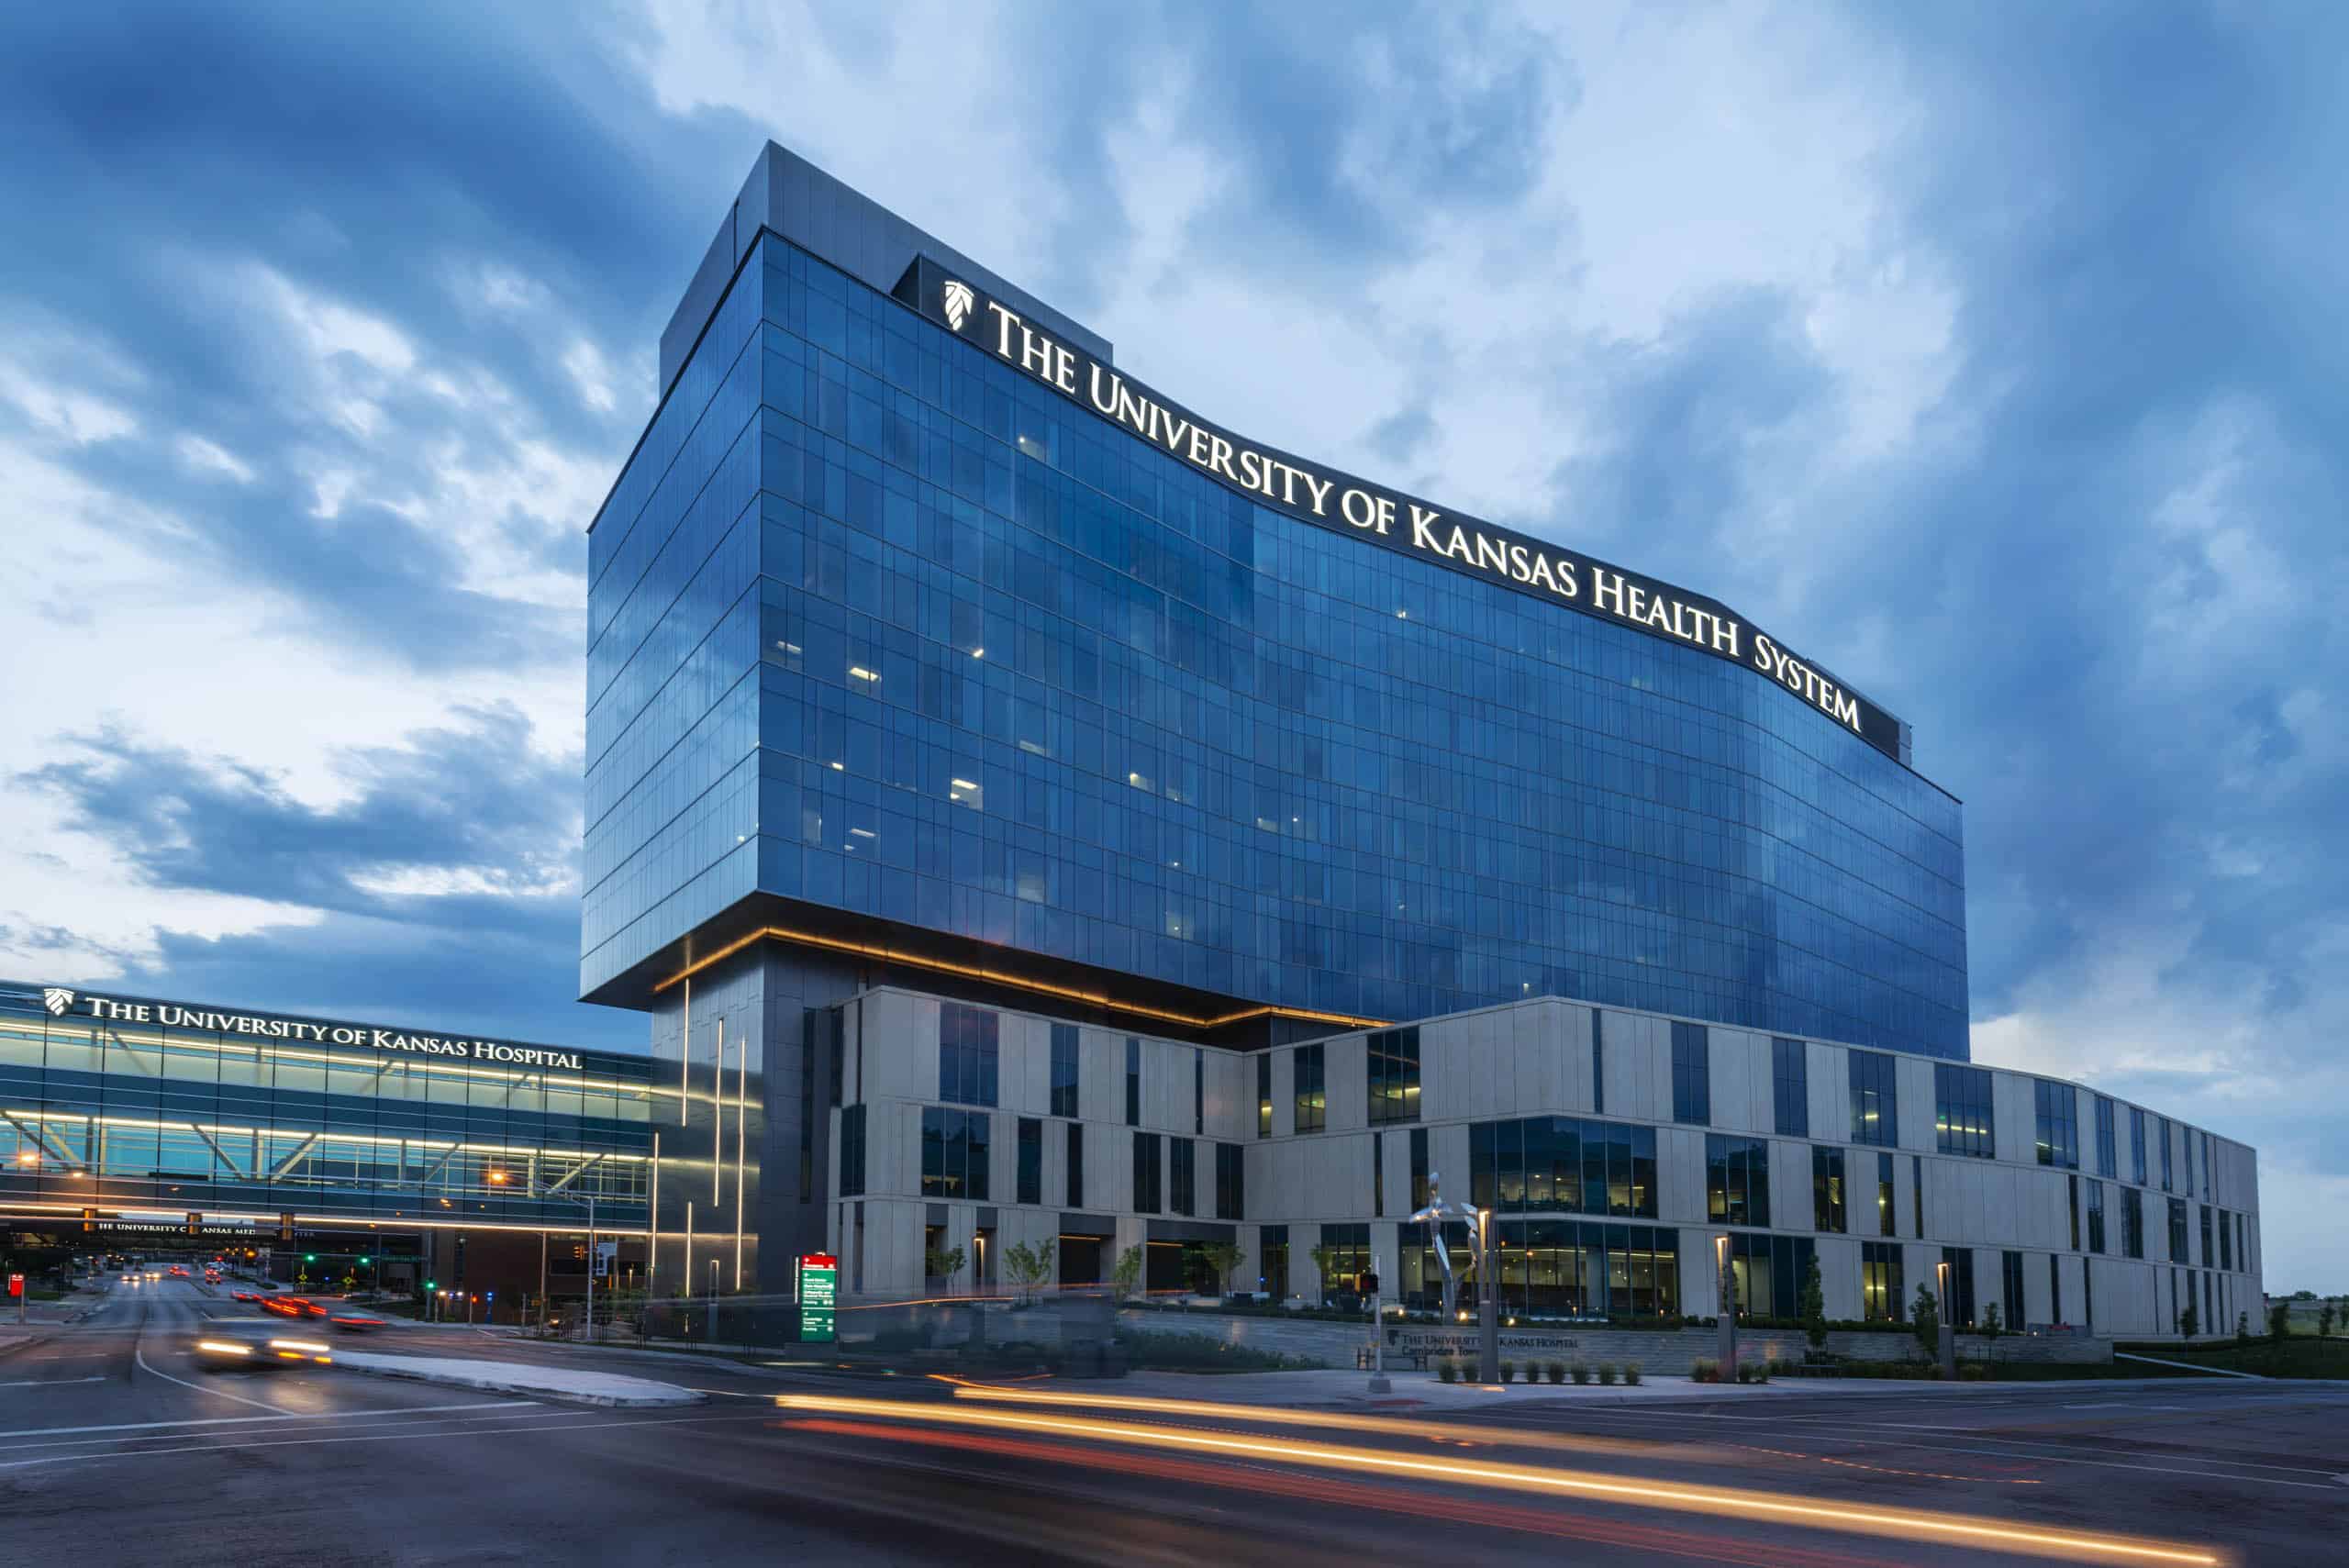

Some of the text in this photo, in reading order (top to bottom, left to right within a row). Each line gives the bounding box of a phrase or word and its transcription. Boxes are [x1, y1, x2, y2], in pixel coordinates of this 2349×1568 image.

[988, 301, 1863, 733] THE UNIVERSITY OF KANSAS HEALTH SYSTEM
[85, 996, 584, 1070] THE UNIVERSITY OF KANSAS HOSPITAL
[117, 1223, 179, 1233] UNIVERSITY
[201, 1227, 232, 1235] ANSAS
[1402, 1334, 1424, 1345] THE
[1498, 1335, 1535, 1348] KANSAS
[1536, 1337, 1579, 1350] HOSPITAL
